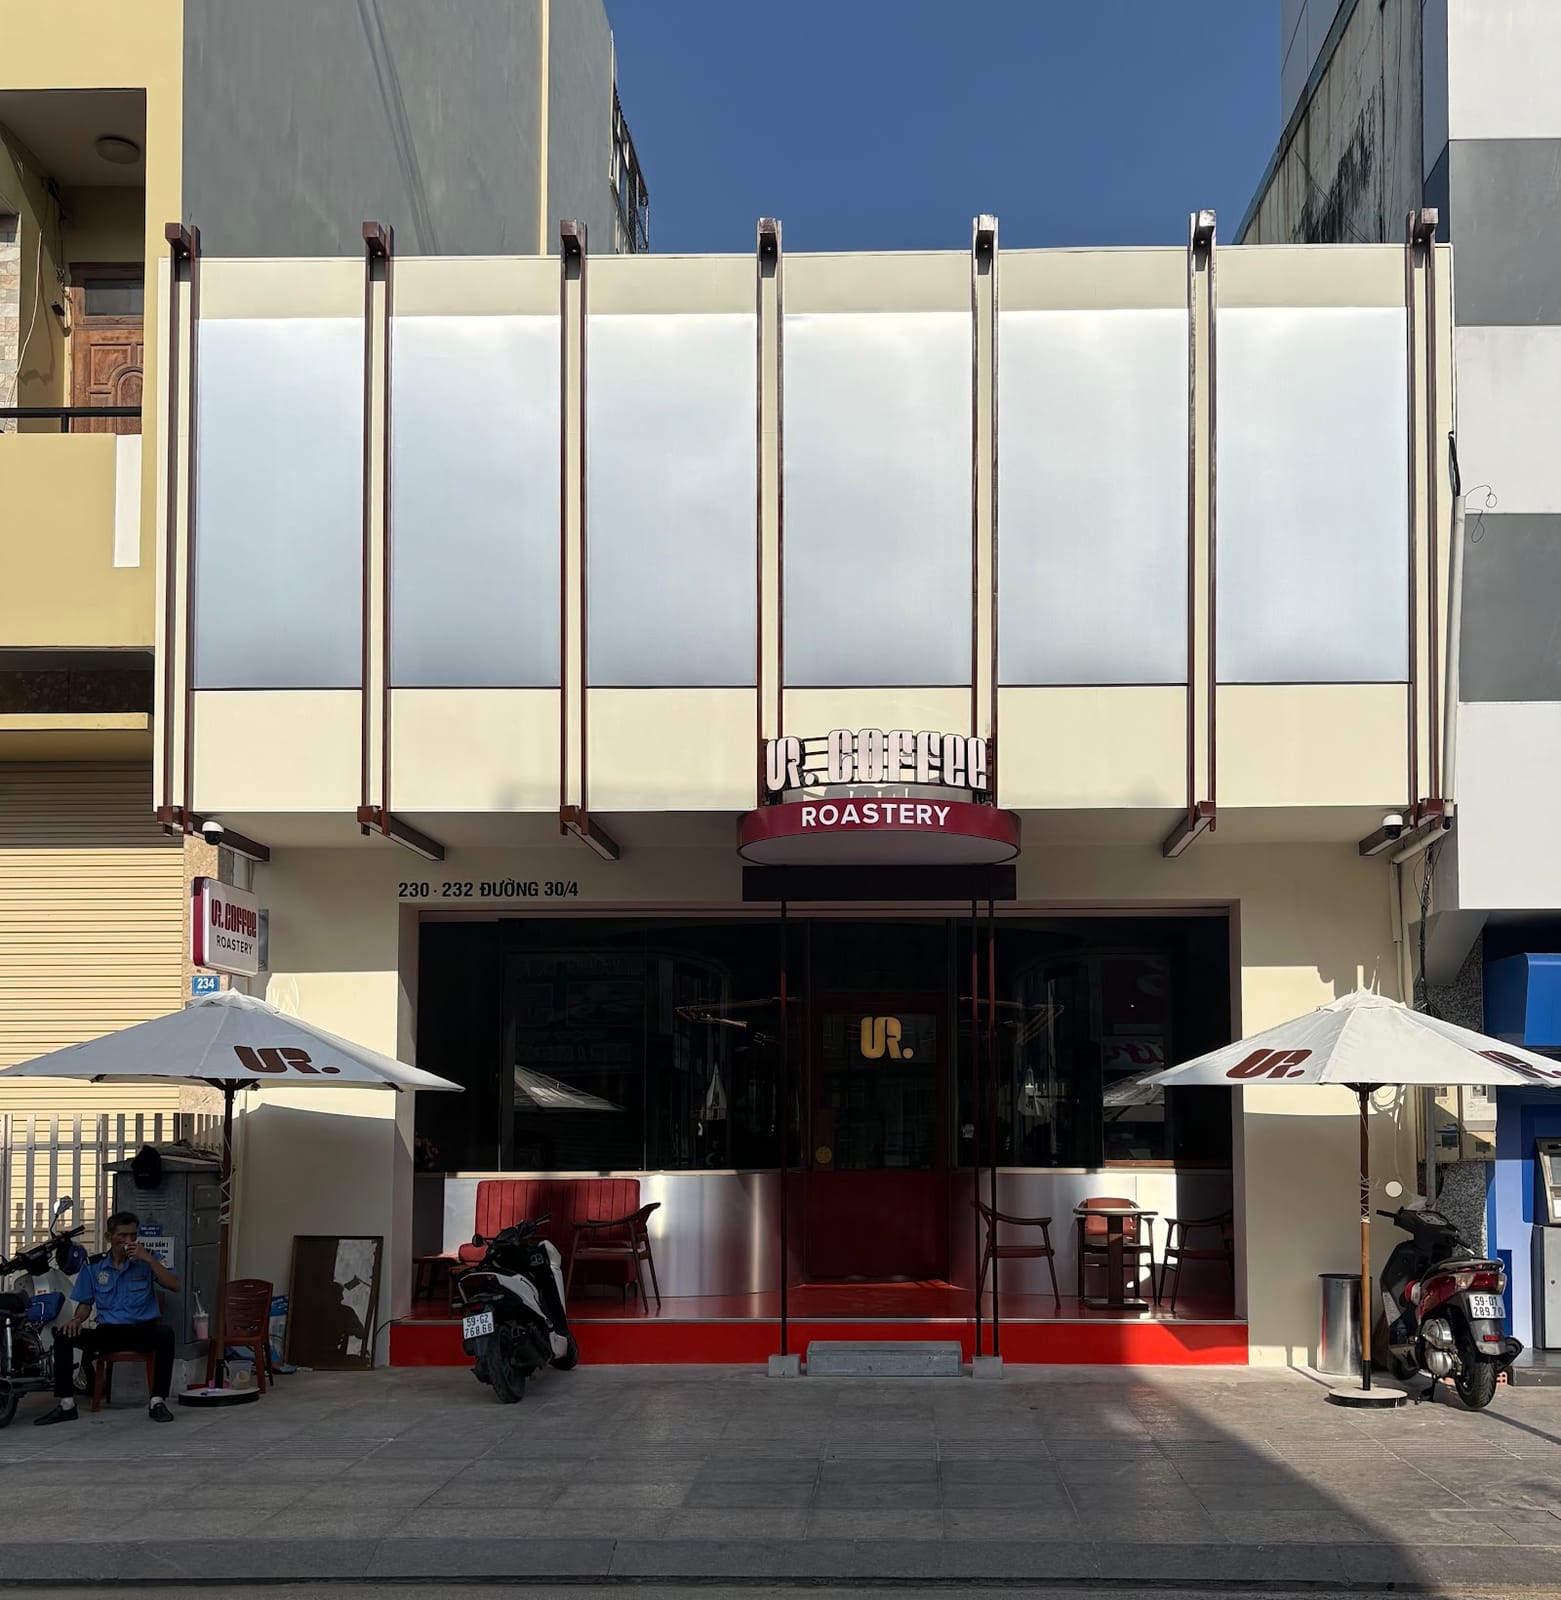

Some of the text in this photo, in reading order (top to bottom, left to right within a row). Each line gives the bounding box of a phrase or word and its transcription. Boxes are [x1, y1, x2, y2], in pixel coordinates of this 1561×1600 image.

[801, 803, 951, 827] ROASTERY
[398, 882, 429, 897] 230
[442, 882, 473, 897] 232
[480, 877, 539, 897] ĐƯỜNG
[544, 881, 578, 897] 30/4
[216, 934, 253, 955] ROASTERY
[198, 977, 215, 989] 234
[860, 1016, 914, 1059] UR.
[234, 1045, 341, 1074] UR.
